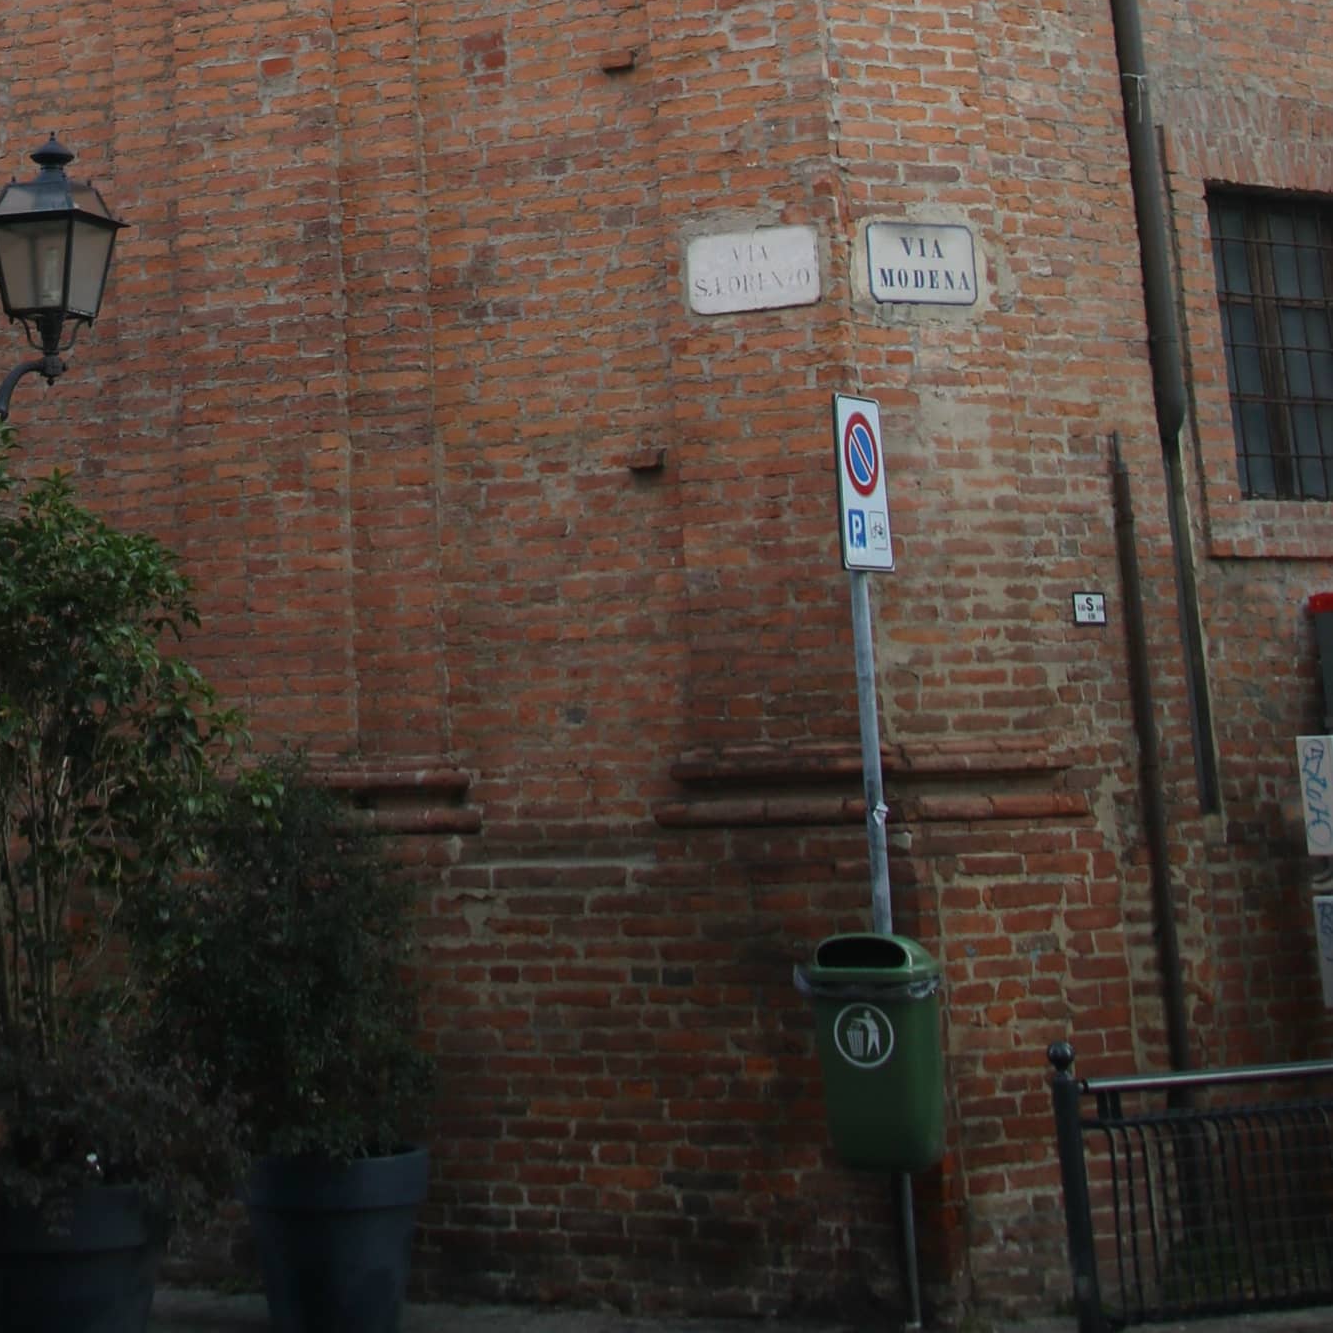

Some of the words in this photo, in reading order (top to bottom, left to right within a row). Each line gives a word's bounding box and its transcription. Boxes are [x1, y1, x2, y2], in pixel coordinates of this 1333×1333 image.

[900, 237, 944, 259] VIA
[879, 267, 971, 291] MODENA
[851, 513, 864, 546] P
[1085, 596, 1094, 612] S
